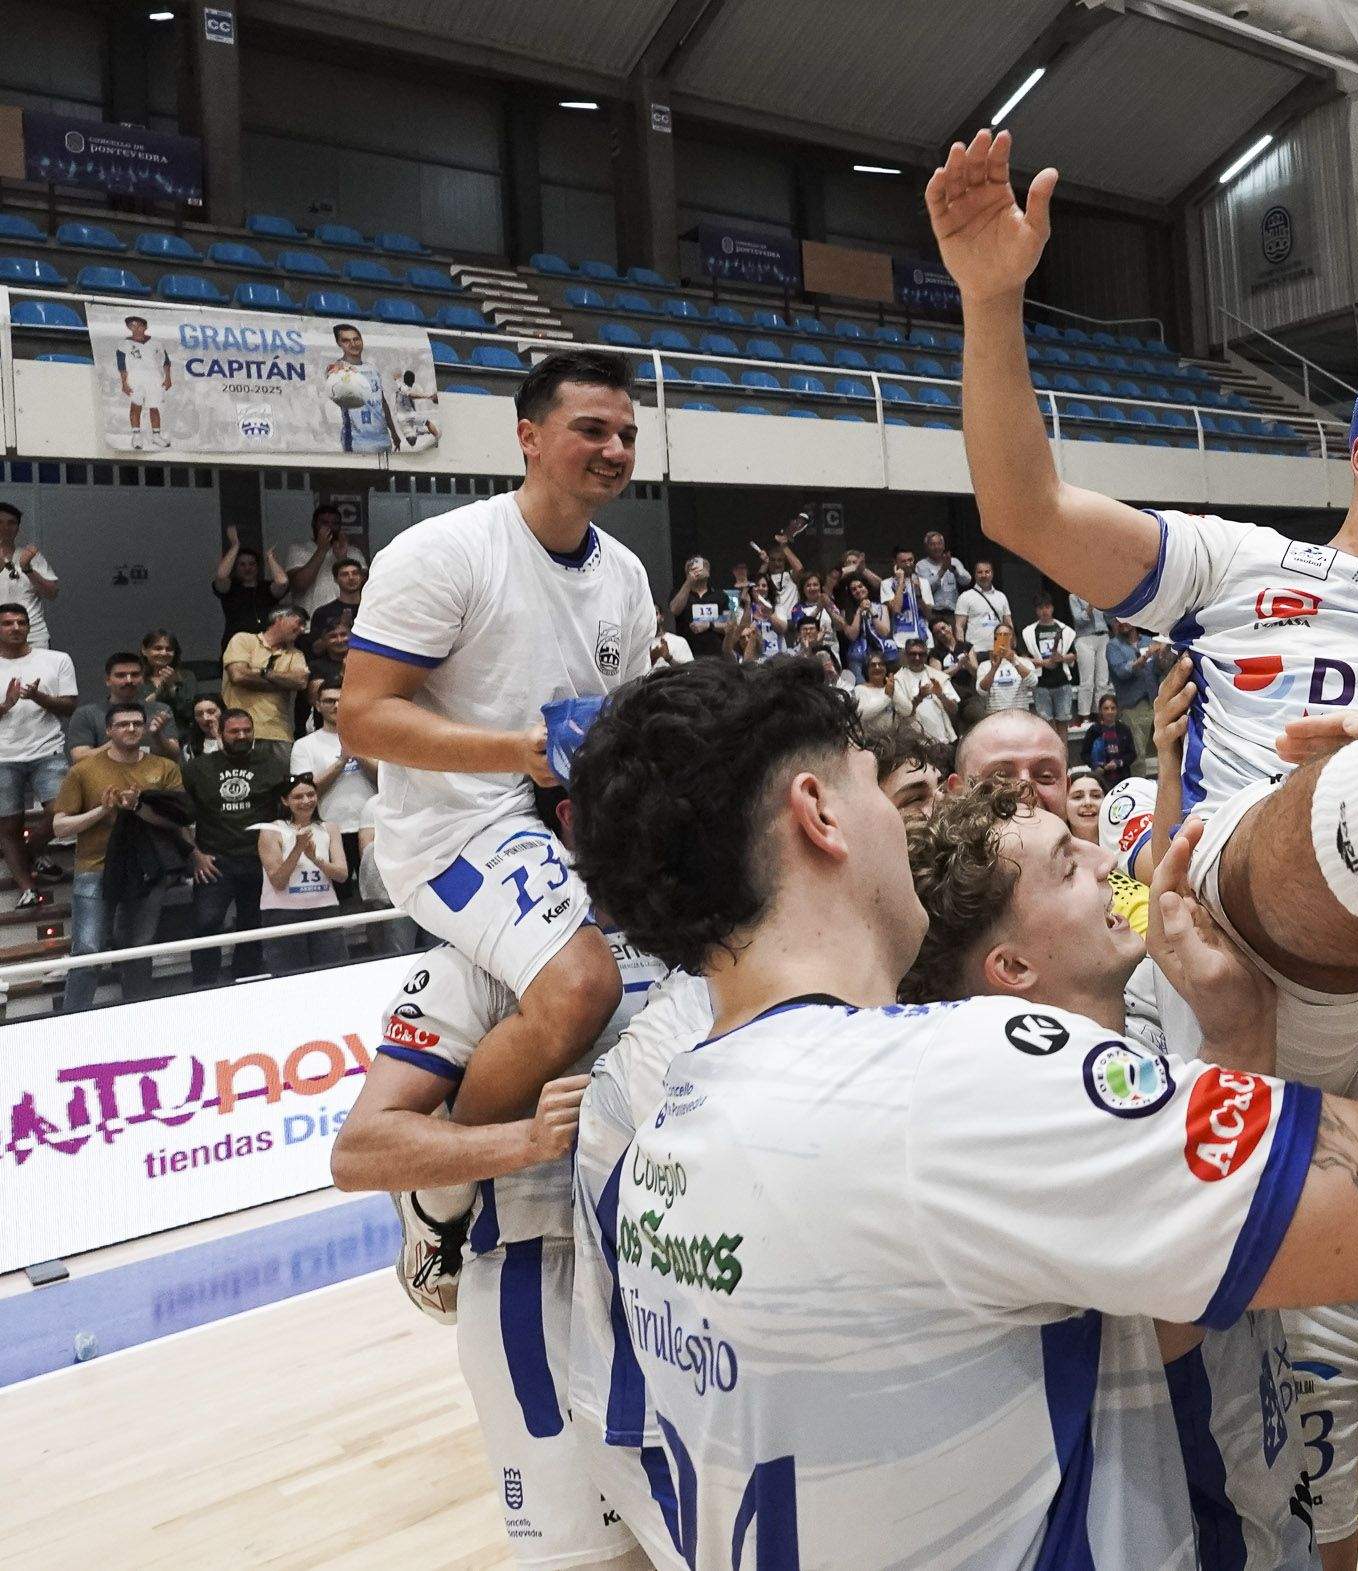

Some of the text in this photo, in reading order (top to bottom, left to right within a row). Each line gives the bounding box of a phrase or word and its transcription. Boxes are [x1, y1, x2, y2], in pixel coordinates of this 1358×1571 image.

[90, 143, 169, 164] PONTEVEDRA
[179, 323, 306, 355] GRACIAS
[185, 354, 306, 381] CAPITÁN
[222, 383, 282, 395] 2000-2025
[826, 510, 840, 526] C
[699, 607, 713, 616] 13
[301, 869, 322, 883] 13
[501, 844, 569, 927] 13
[1011, 1015, 1064, 1051] K
[144, 1129, 274, 1179] tiendas
[632, 1143, 687, 1209] Colegio
